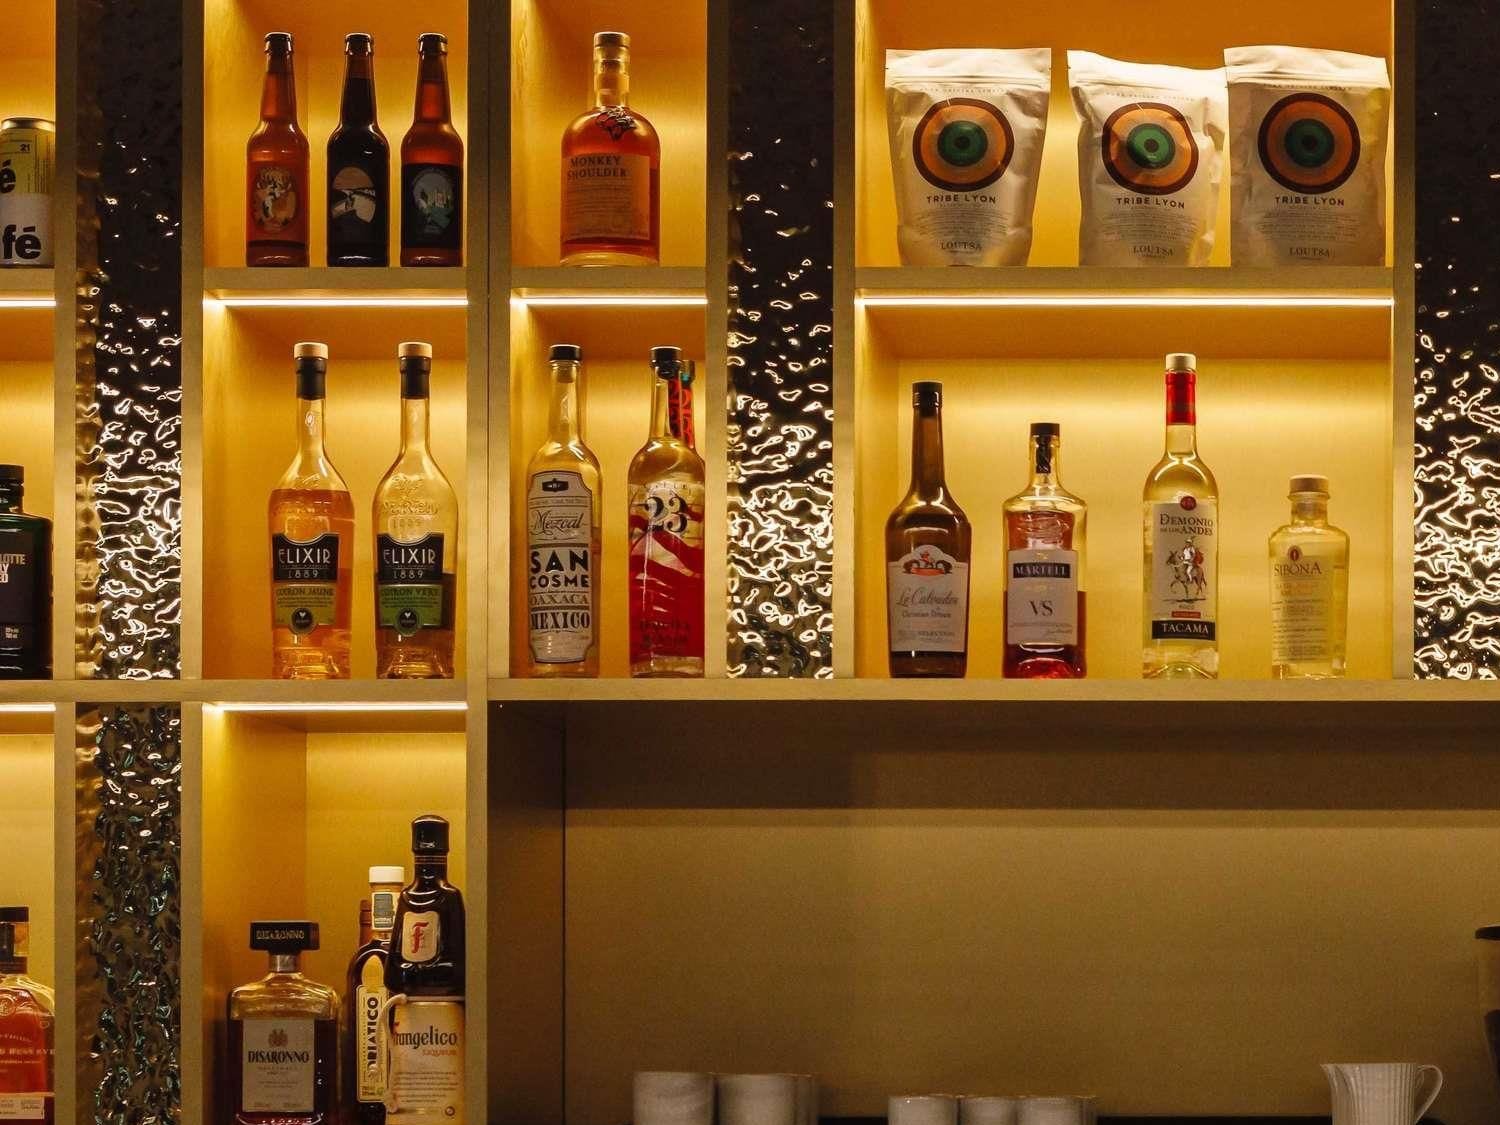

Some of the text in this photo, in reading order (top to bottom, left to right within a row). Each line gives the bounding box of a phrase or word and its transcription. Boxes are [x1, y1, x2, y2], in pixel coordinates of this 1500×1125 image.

[571, 155, 621, 167] MONKEY
[567, 167, 626, 180] SHOULDER
[926, 194, 996, 204] TRIBE LYON
[1116, 197, 1185, 209] TRIBE LYON
[1275, 197, 1345, 206] TRIBE LYON
[531, 509, 584, 535] Mezcal
[1159, 513, 1214, 527] DEMONIO
[1179, 526, 1213, 536] ANDES
[278, 548, 332, 564] ELIXIR
[383, 548, 436, 564] ELIXIR
[530, 550, 589, 574] SAN
[288, 570, 319, 579] 1889
[393, 570, 424, 579] 1889
[1015, 564, 1068, 576] MARTELL
[530, 574, 590, 589] COSME
[530, 593, 589, 605] OAXACA
[1029, 600, 1054, 617] VS
[530, 611, 591, 630] MEXICO
[1161, 623, 1209, 634] TACAMA
[248, 1050, 310, 1064] DISARONNO
